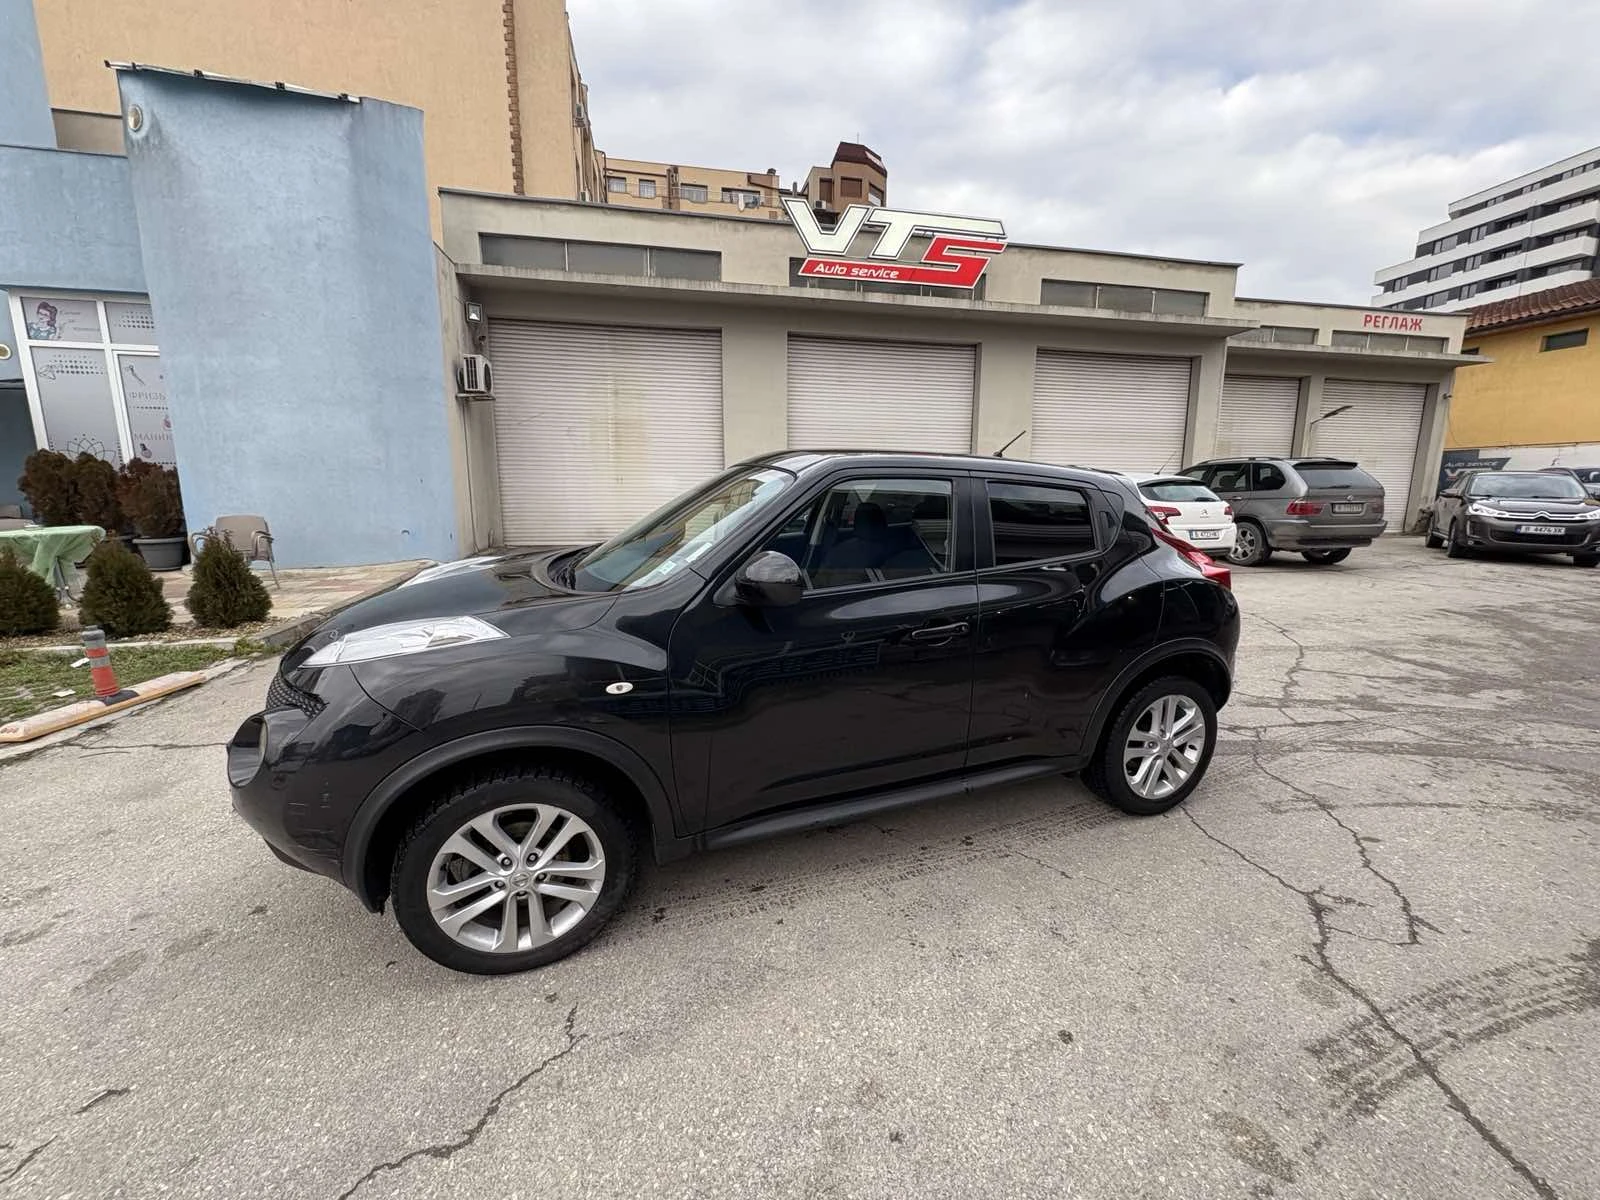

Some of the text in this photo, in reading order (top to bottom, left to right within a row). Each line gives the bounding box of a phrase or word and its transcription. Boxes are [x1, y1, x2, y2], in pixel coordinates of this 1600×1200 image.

[781, 197, 1007, 288] VTS
[813, 262, 899, 279] Auto service
[1363, 314, 1424, 332] РЕГЛАЖ
